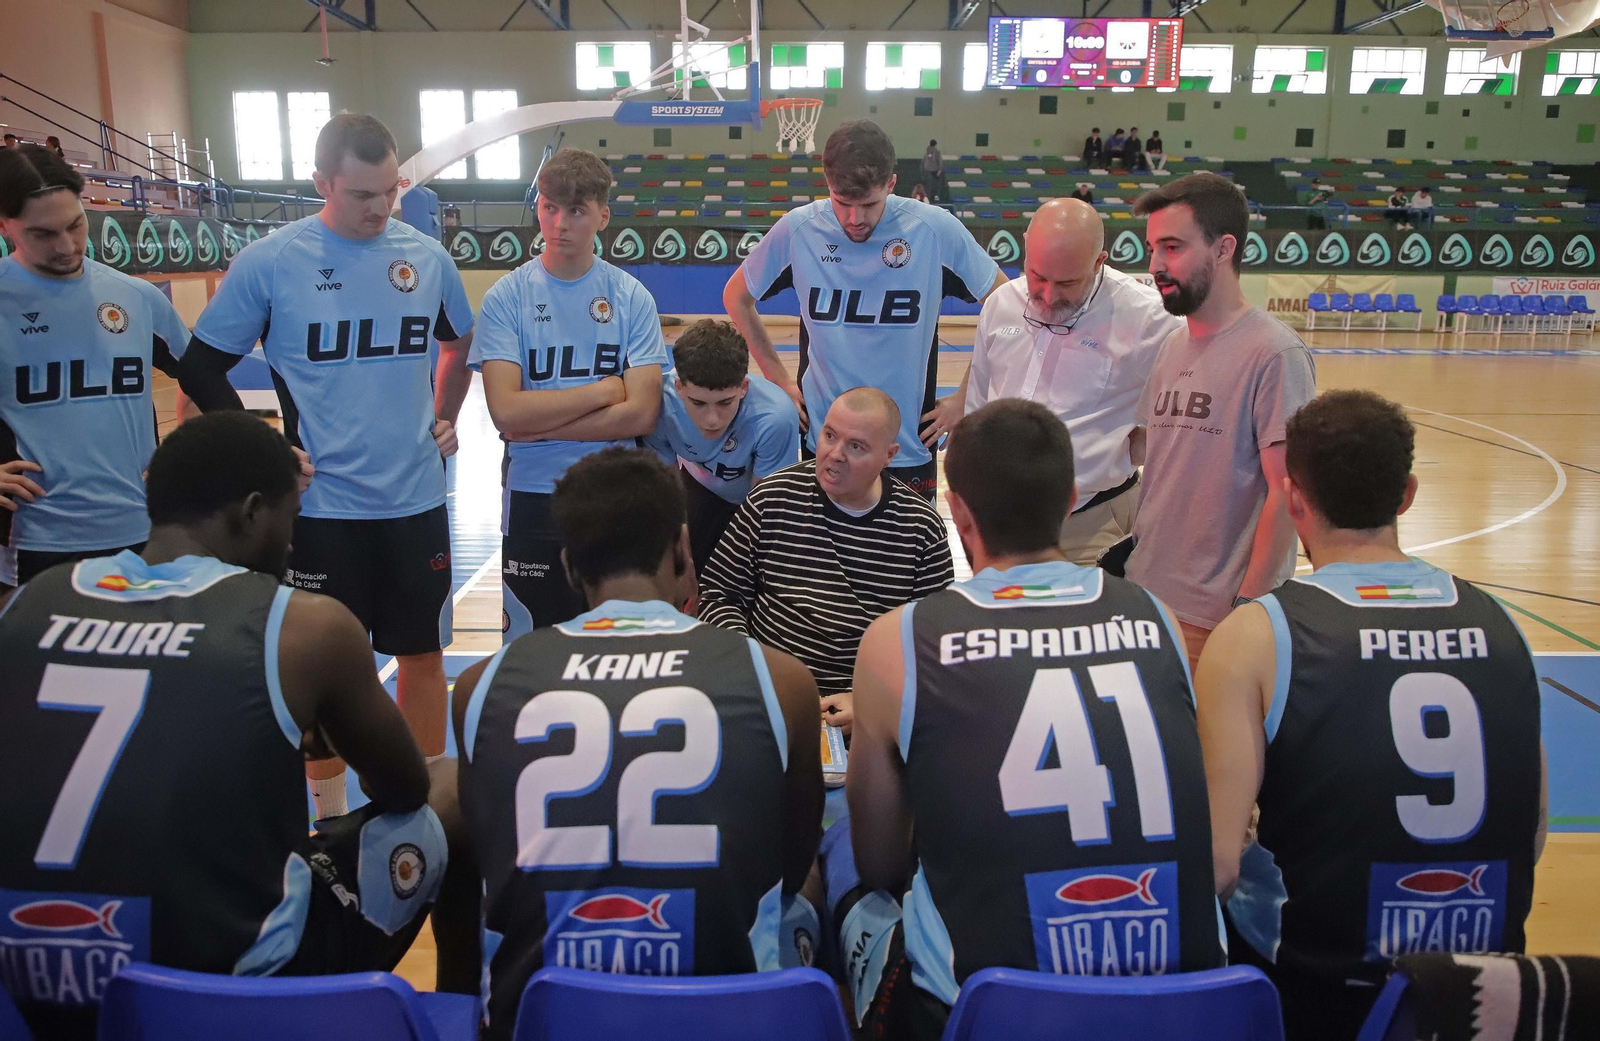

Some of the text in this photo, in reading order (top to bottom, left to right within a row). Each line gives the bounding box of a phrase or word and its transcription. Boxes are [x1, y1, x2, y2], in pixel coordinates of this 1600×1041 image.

[315, 282, 343, 291] vive
[1541, 280, 1566, 290] Ruiz
[807, 287, 921, 324] ULB
[20, 324, 49, 335] vive
[307, 316, 430, 362] ULB
[1001, 327, 1021, 336] ULB
[16, 357, 144, 405] ULB
[528, 344, 620, 381] ULB
[1154, 391, 1212, 420] ULB
[295, 571, 327, 580] Diputación
[38, 614, 206, 658] TOURE
[939, 614, 1162, 666] ESPADIÑA
[1359, 627, 1489, 661] PEREA
[561, 649, 690, 681] KANE
[34, 662, 151, 870] 7
[998, 661, 1176, 847] 41
[1388, 672, 1487, 845] 9
[513, 686, 722, 871] 22
[1048, 918, 1168, 976] UBAGO
